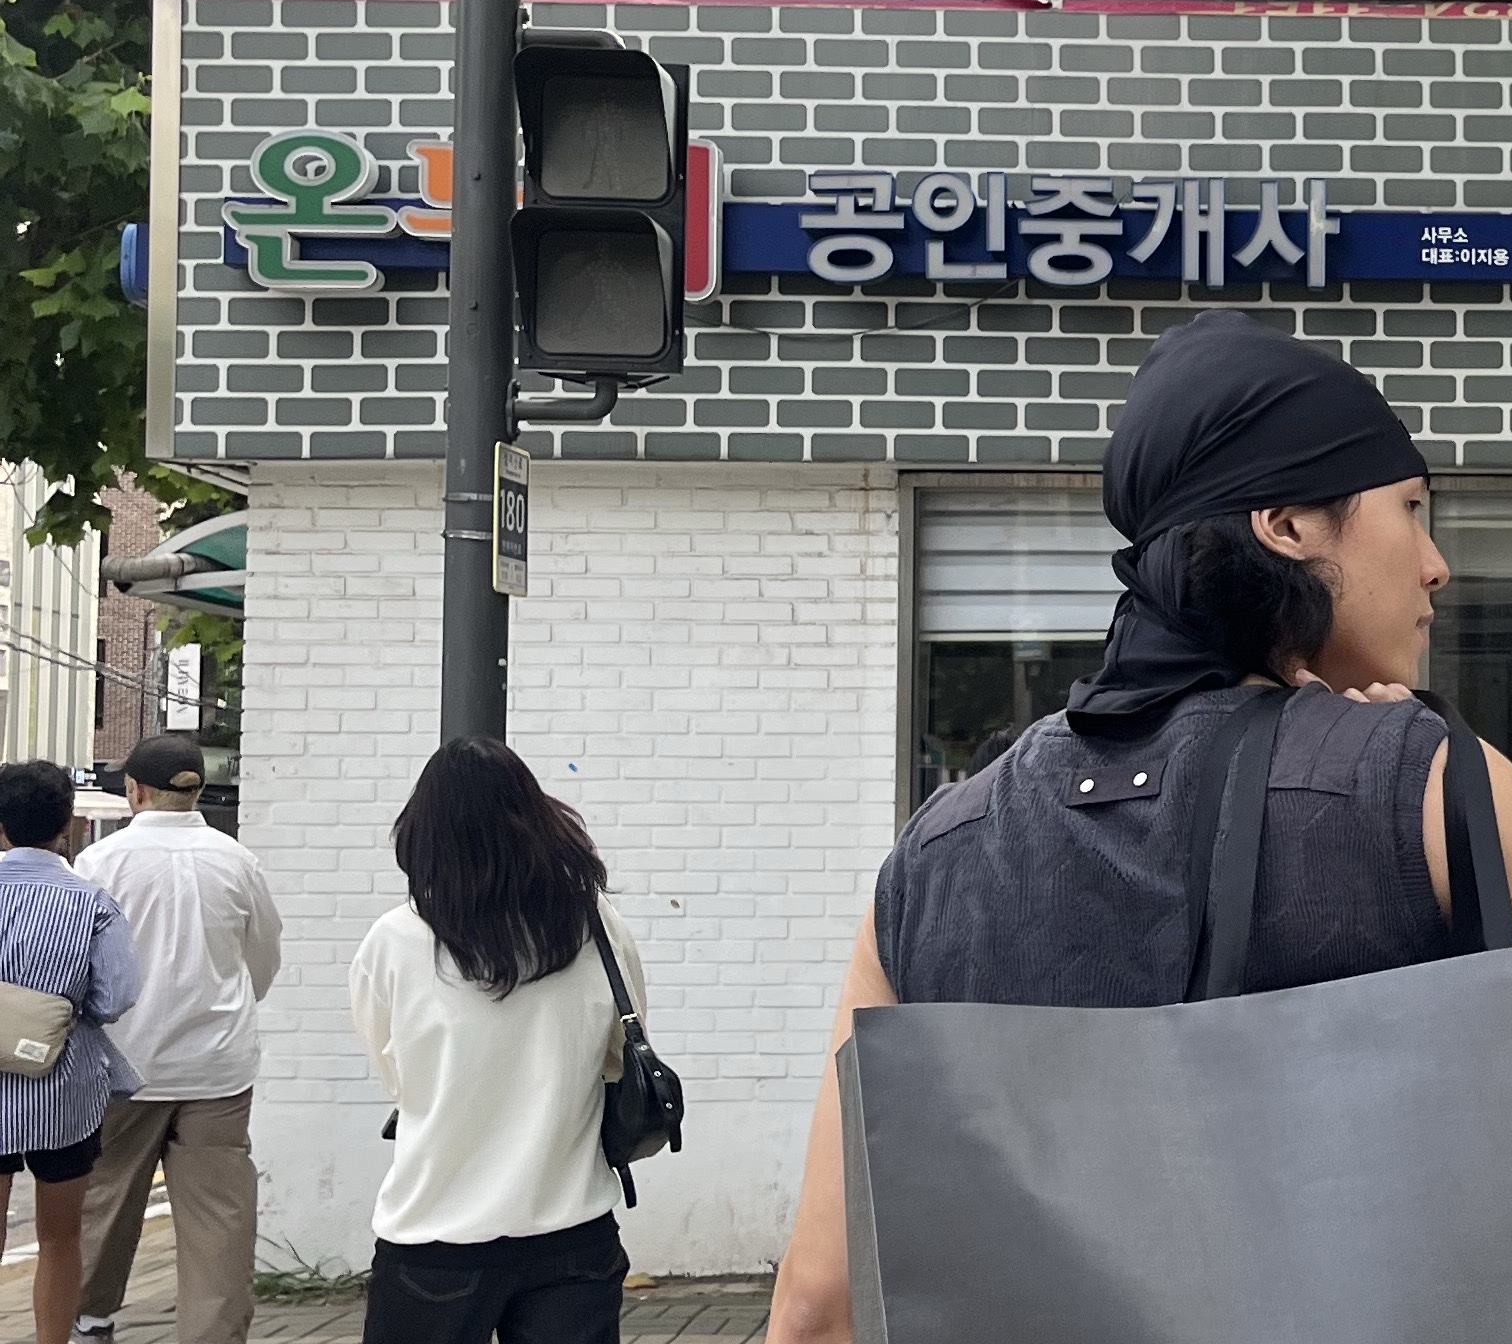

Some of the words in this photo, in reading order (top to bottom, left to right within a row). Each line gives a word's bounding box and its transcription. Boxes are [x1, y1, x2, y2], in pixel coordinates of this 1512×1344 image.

[799, 171, 1341, 290] 공인중개사
[1421, 226, 1469, 244] 사무소
[500, 488, 526, 534] 180
